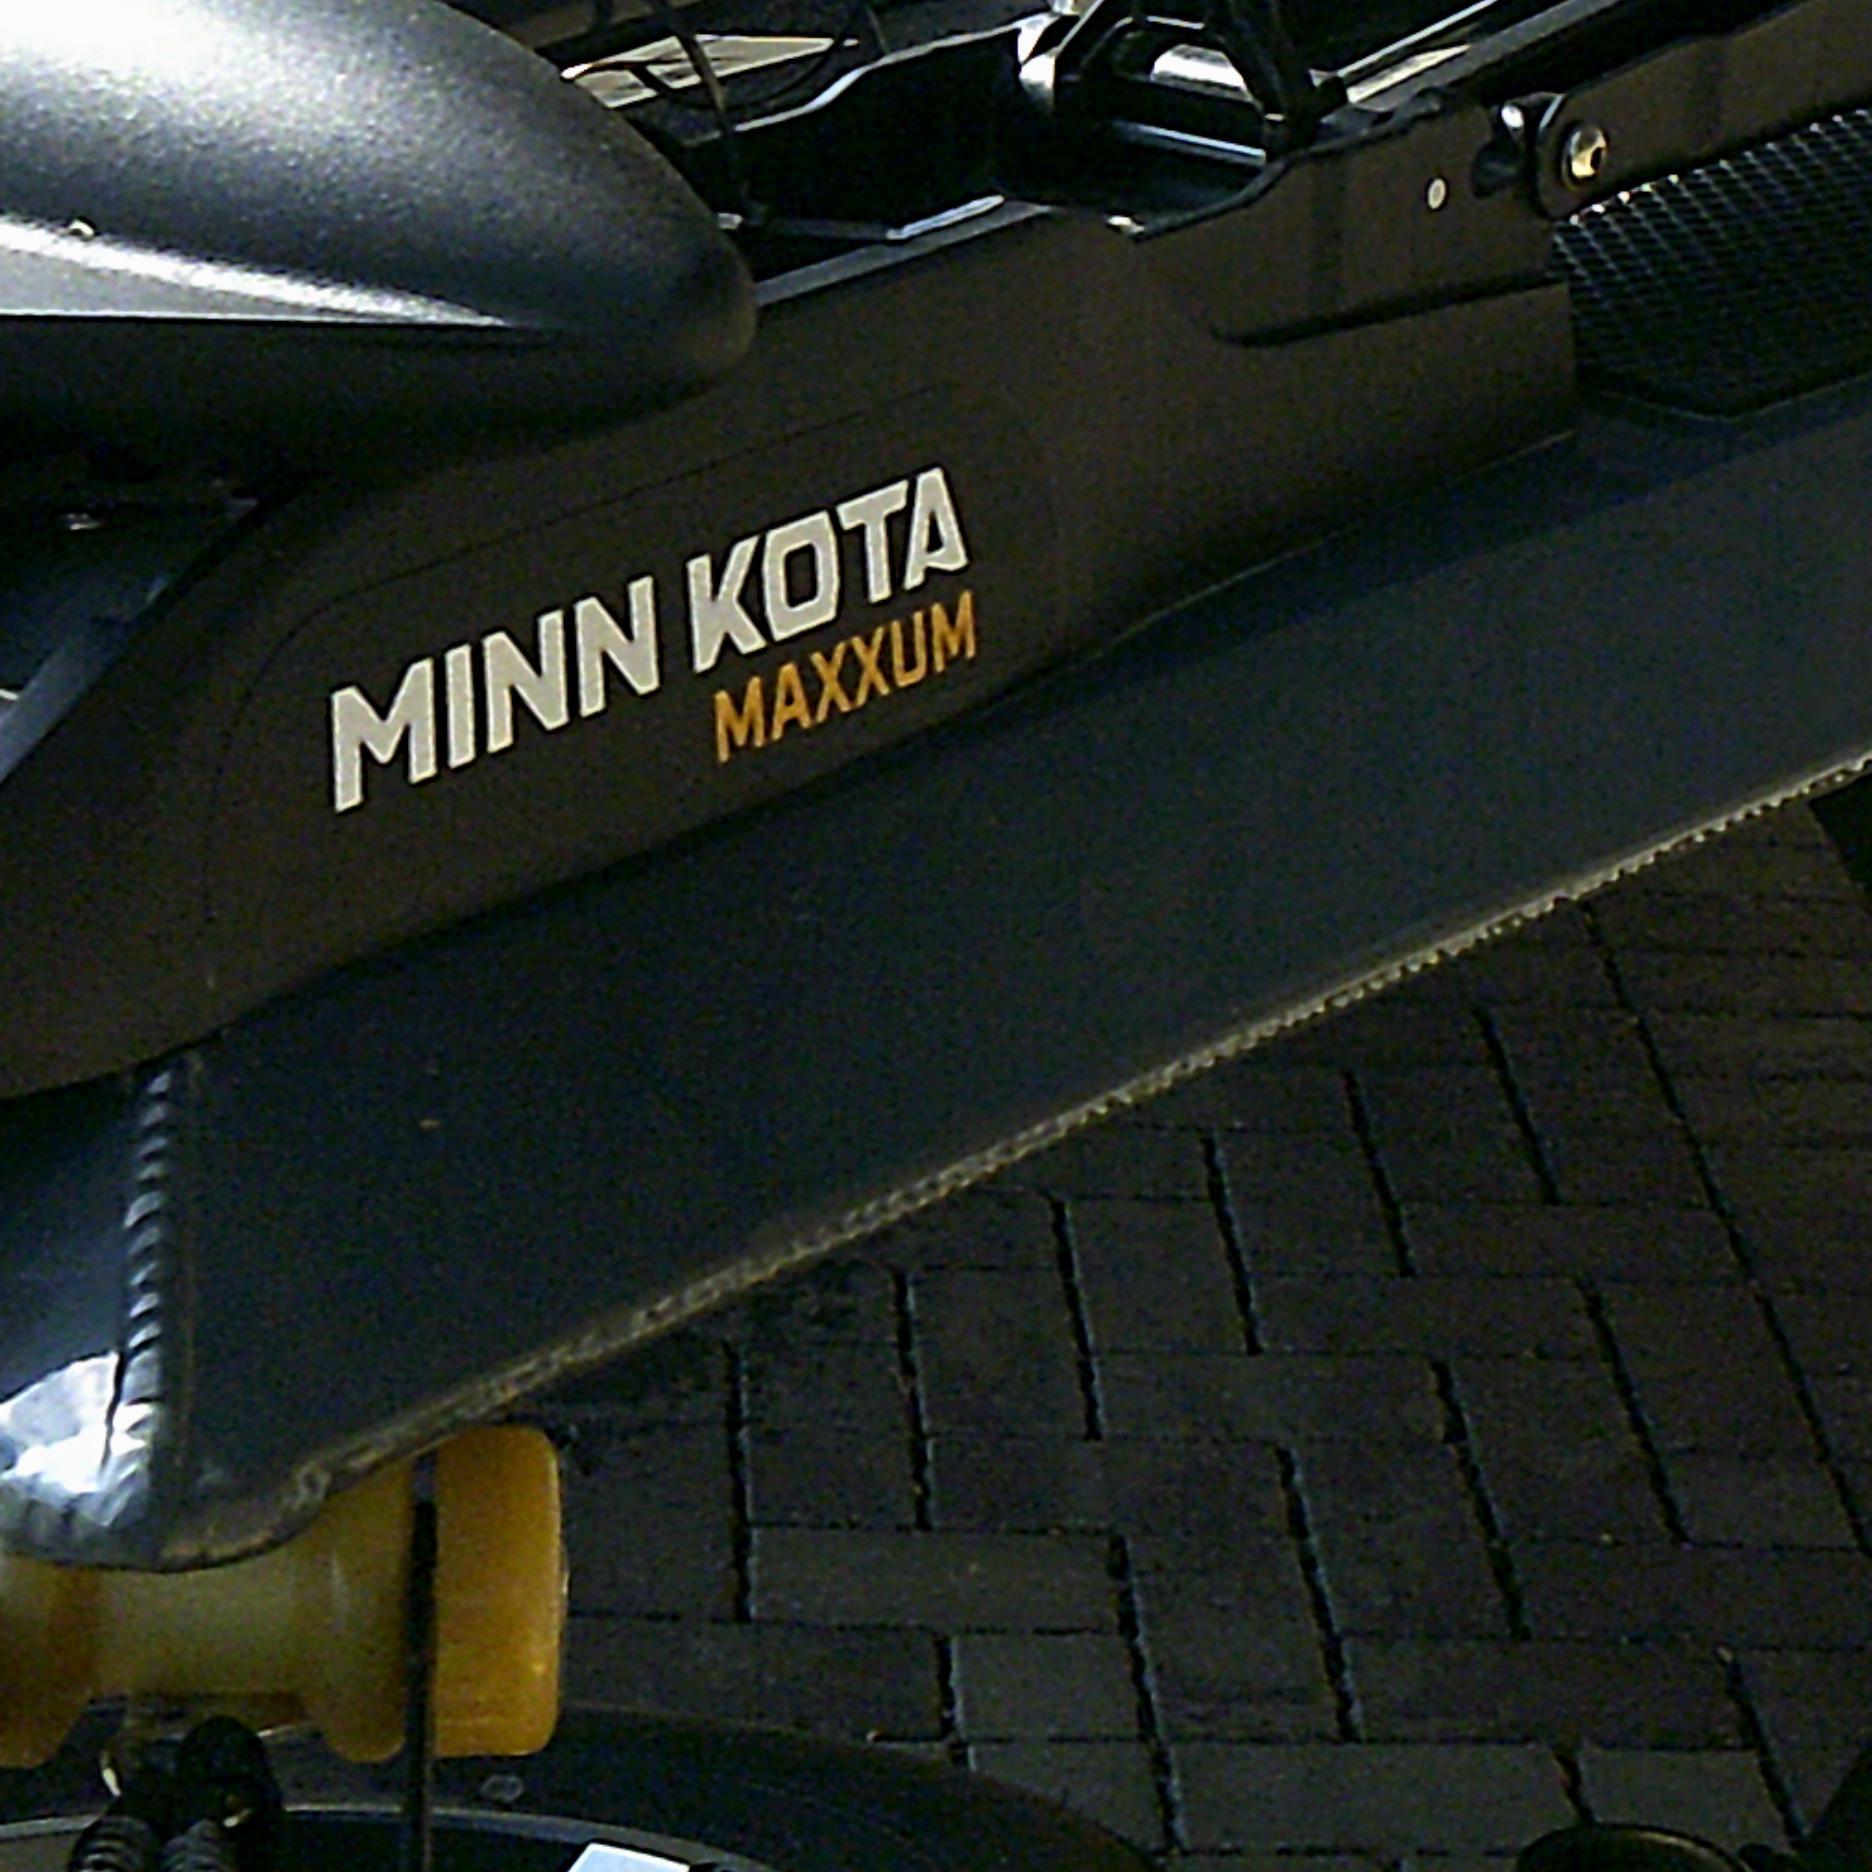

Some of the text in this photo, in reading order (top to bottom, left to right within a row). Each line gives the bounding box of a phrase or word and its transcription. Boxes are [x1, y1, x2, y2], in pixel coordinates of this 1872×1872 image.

[330, 466, 970, 813] MINN KOTA
[713, 590, 977, 763] MAXXUM
